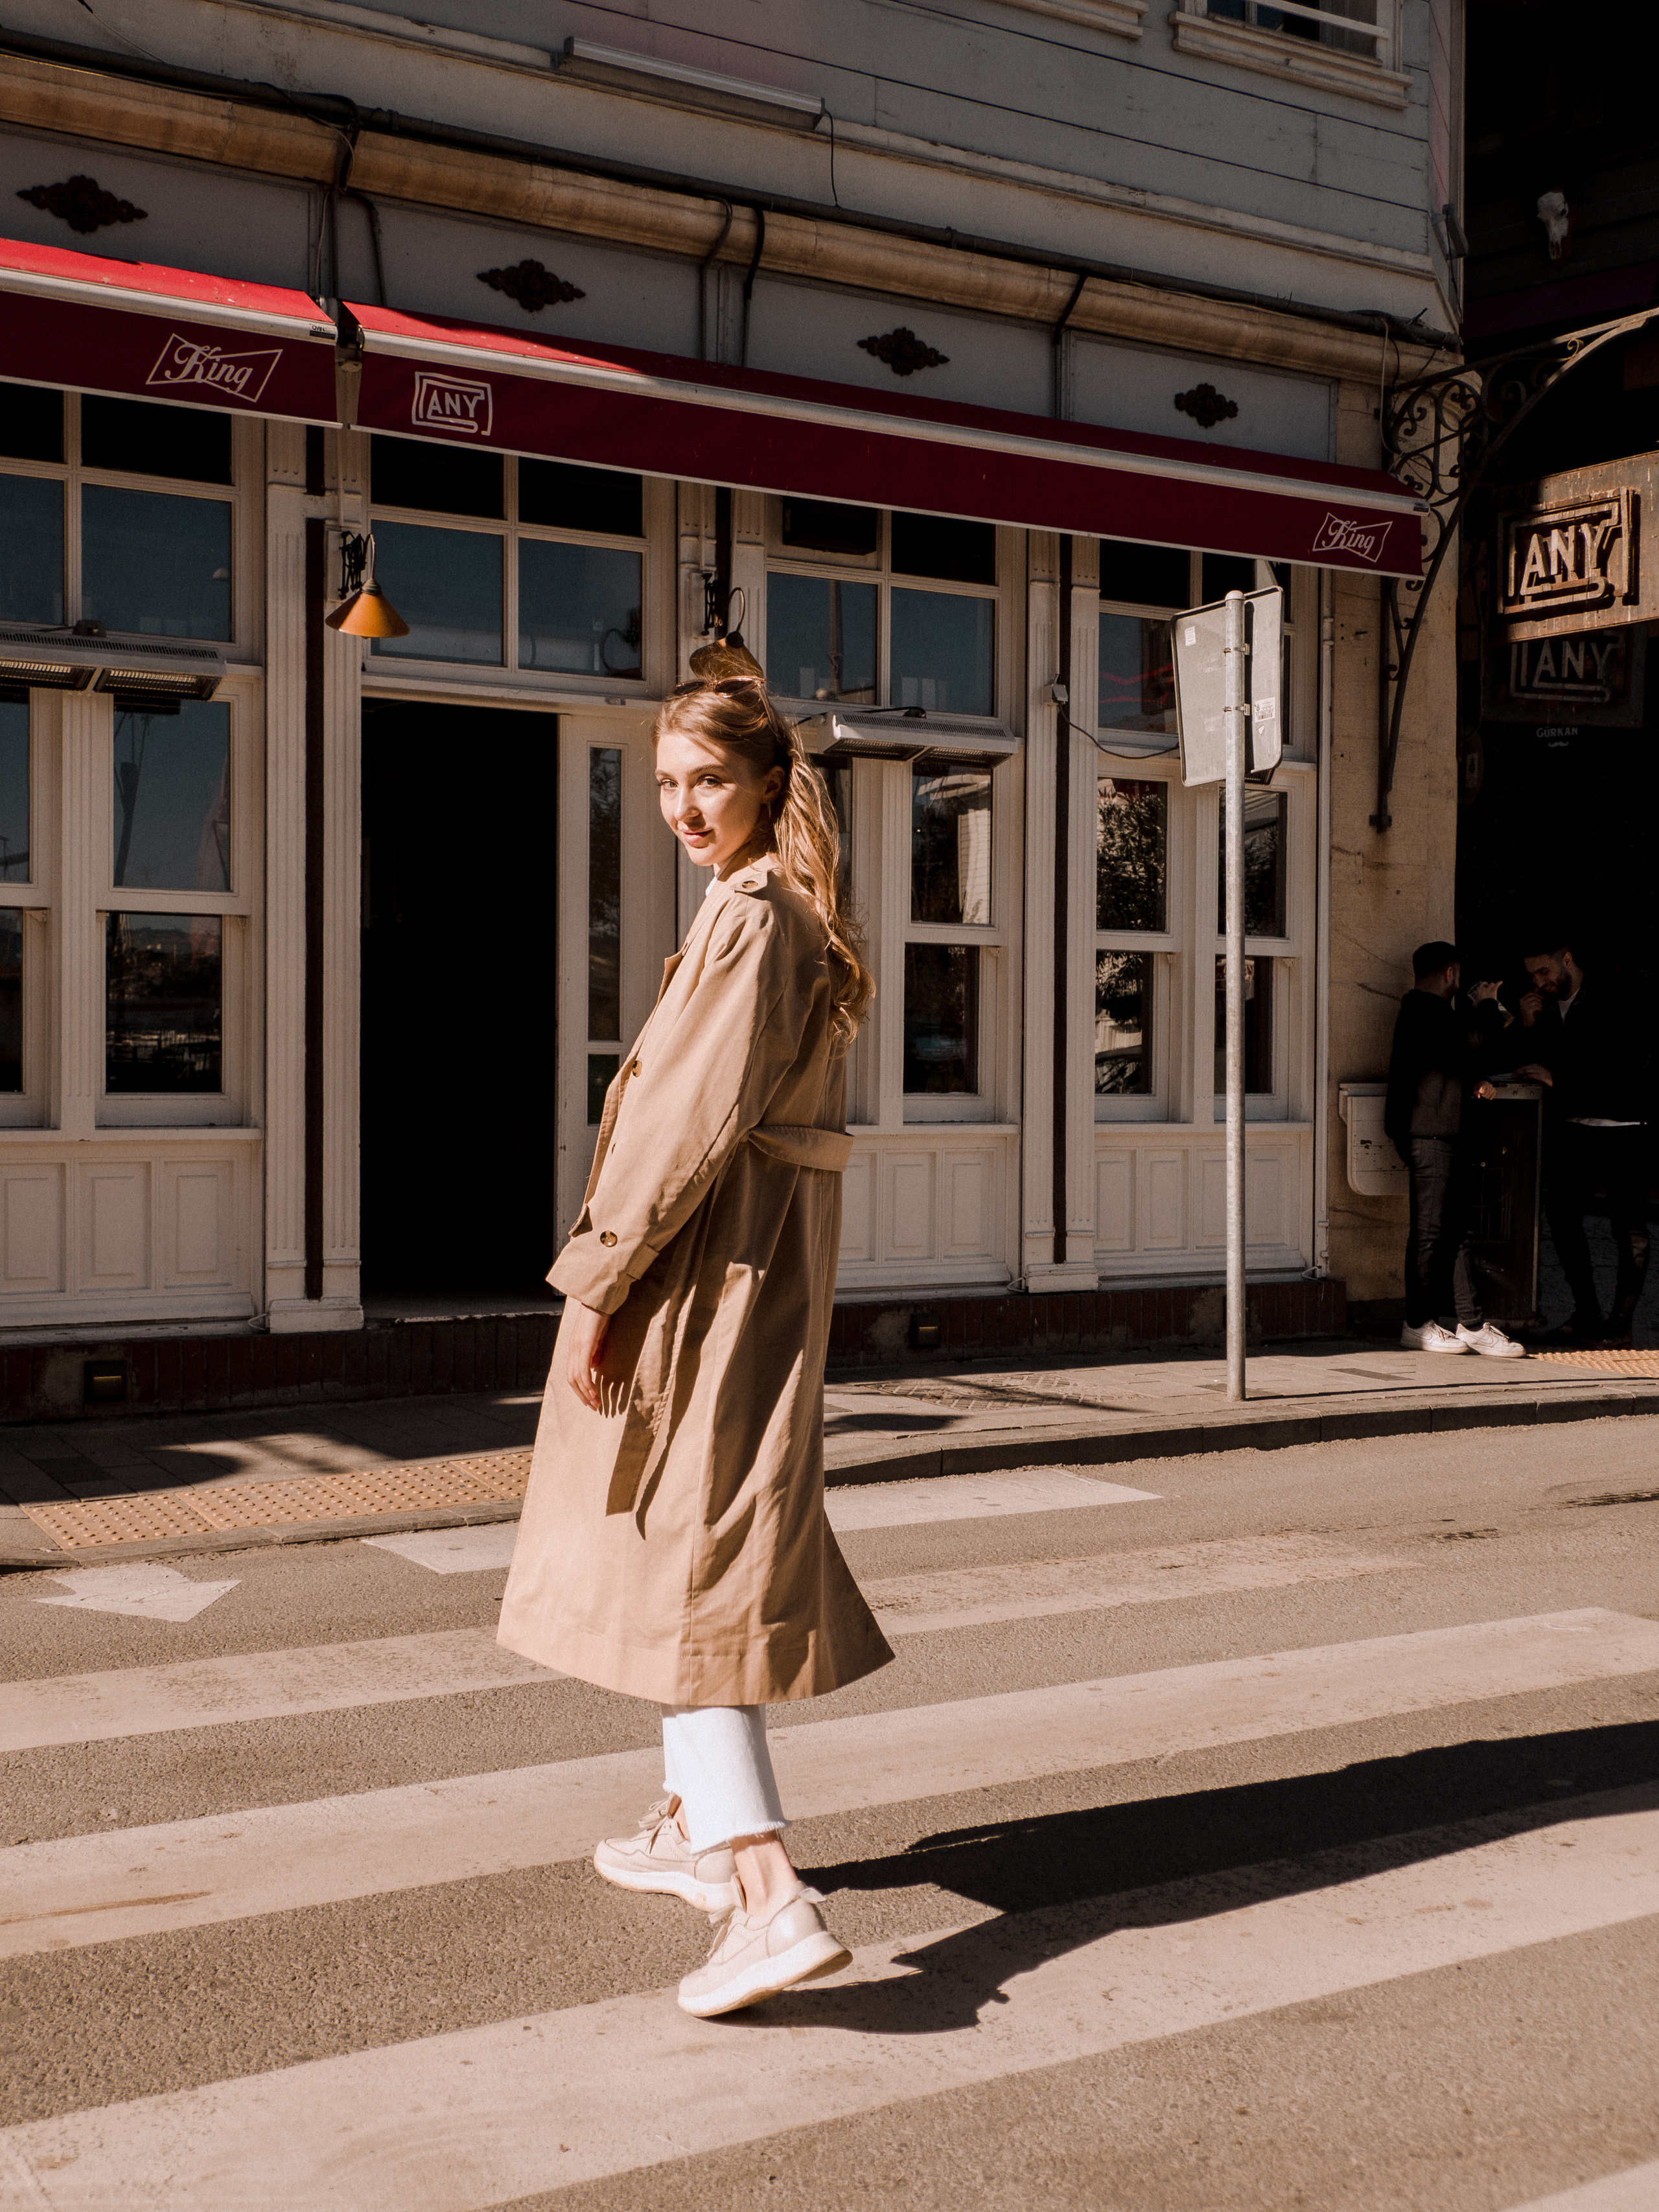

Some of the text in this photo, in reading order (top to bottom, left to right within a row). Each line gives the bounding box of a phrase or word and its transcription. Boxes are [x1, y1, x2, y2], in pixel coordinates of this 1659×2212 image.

[164, 343, 253, 393] King
[426, 389, 479, 419] ANY
[1321, 520, 1375, 556] King
[1520, 523, 1607, 593] ANY
[1533, 639, 1612, 687] ANY
